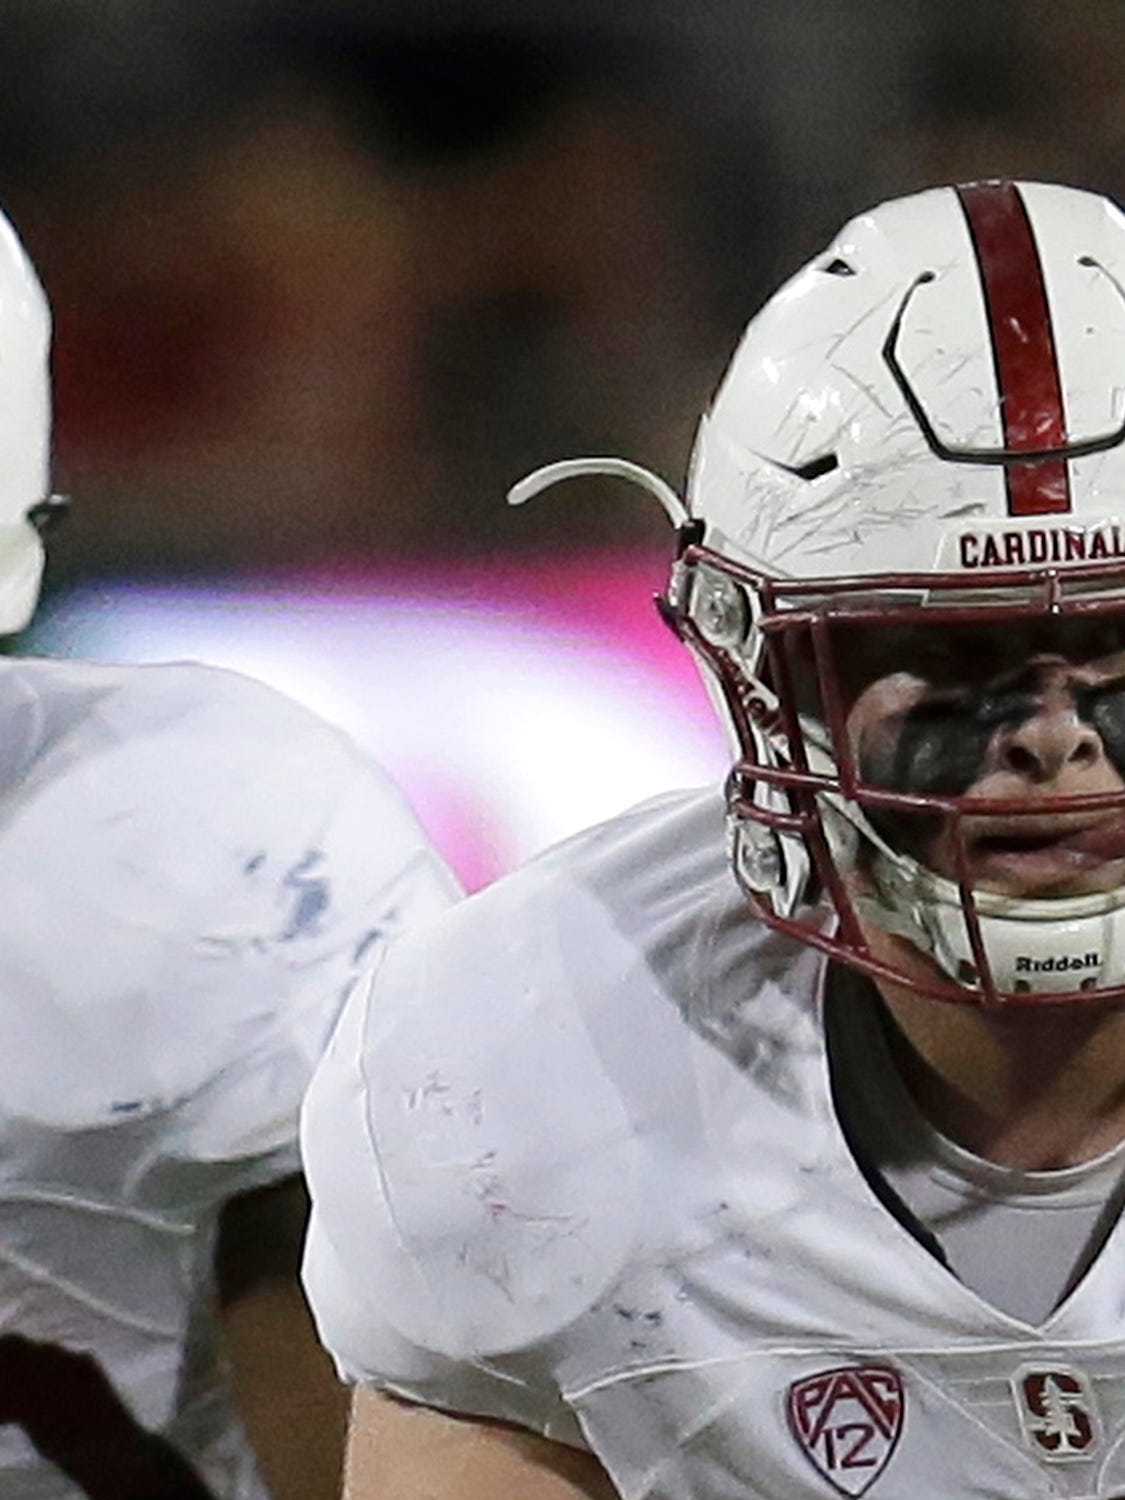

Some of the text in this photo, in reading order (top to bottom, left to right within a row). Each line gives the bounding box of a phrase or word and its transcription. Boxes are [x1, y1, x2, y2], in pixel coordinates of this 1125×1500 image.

[1015, 953, 1099, 972] Riddell
[794, 1368, 902, 1448] PAC
[822, 1423, 876, 1469] 12
